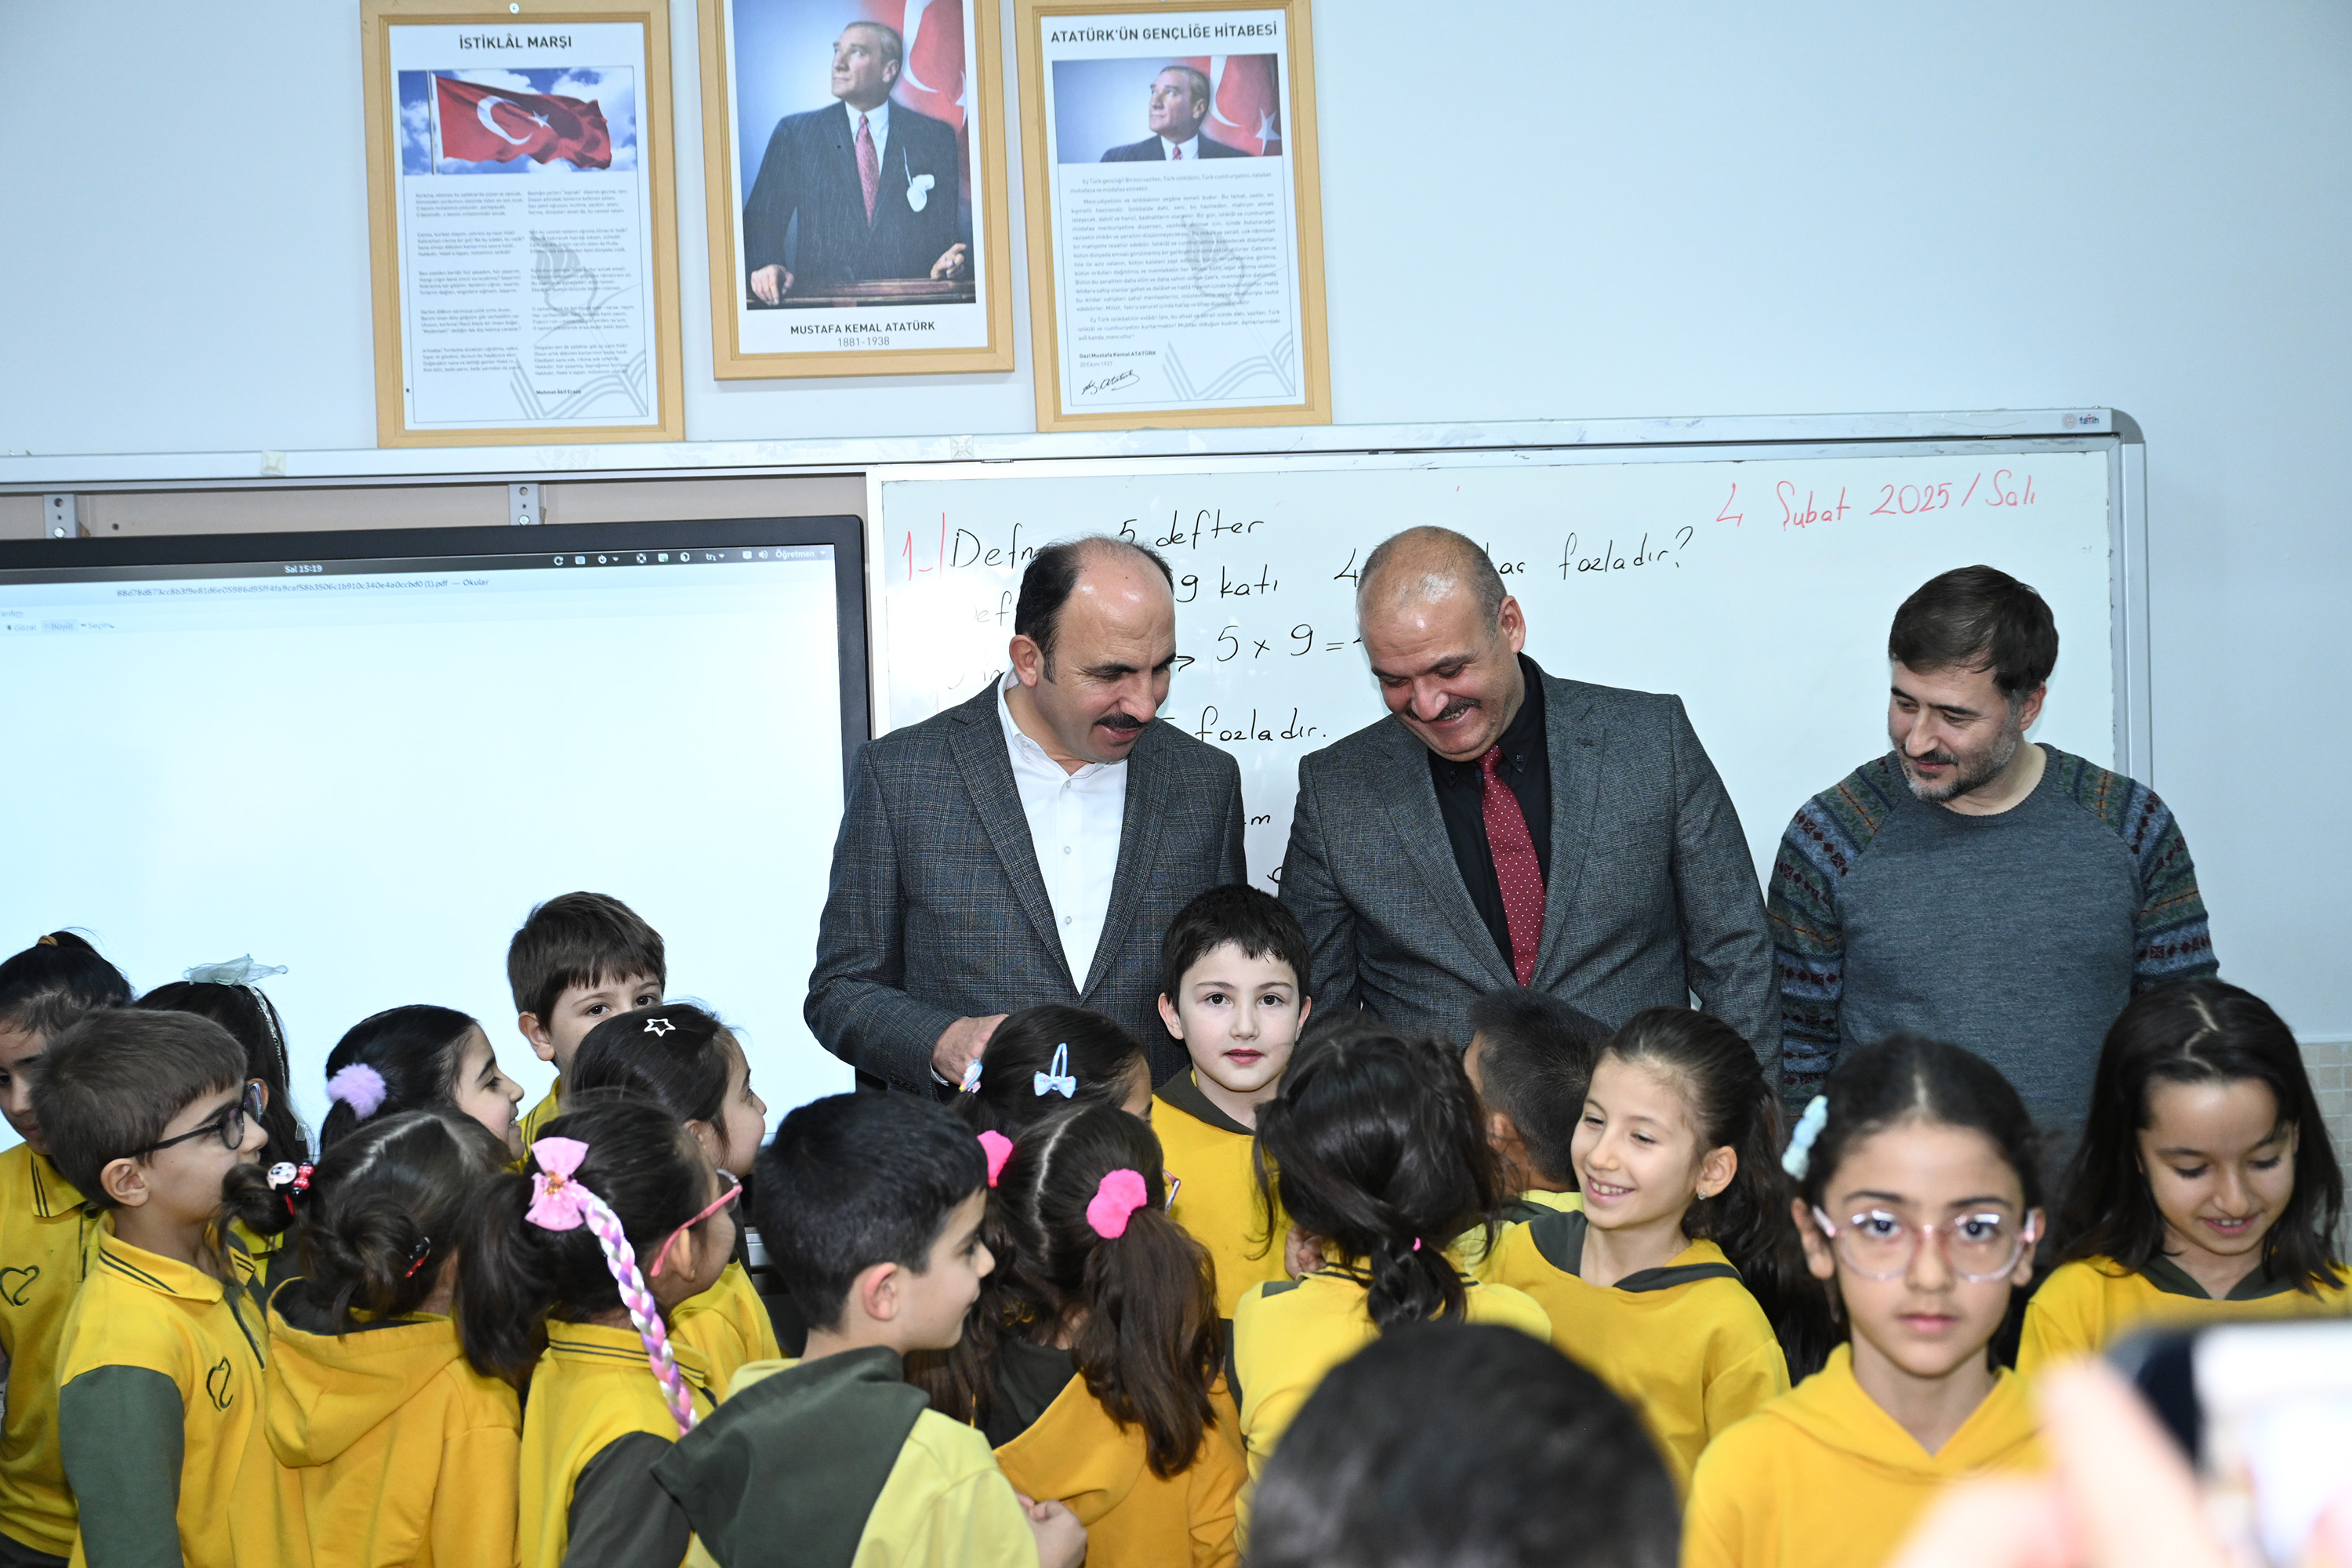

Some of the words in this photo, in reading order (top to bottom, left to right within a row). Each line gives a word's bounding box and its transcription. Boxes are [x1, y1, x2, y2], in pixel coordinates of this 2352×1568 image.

[459, 33, 524, 50] İSTİKLÂL
[527, 35, 573, 49] MARŞI
[1051, 26, 1138, 43] ATATÜRK'ÜN
[1142, 23, 1211, 41] GENÇLİĞE
[1214, 20, 1278, 38] HİTABESİ
[790, 324, 842, 335] MUSTAFA
[844, 322, 882, 333] KEMAL
[884, 319, 936, 332] ATATÜRK
[837, 336, 890, 347] 1881-1938
[1715, 481, 1744, 528] 4
[1776, 480, 1852, 532] Şubat
[949, 522, 1036, 571] Defn
[1155, 508, 1265, 550] defter
[299, 564, 323, 573] 15:19
[775, 549, 815, 561] Öğretmen
[463, 579, 489, 587] Okular
[1219, 563, 1279, 600] katı
[1216, 625, 1239, 662] 5
[1290, 623, 1315, 657] 9
